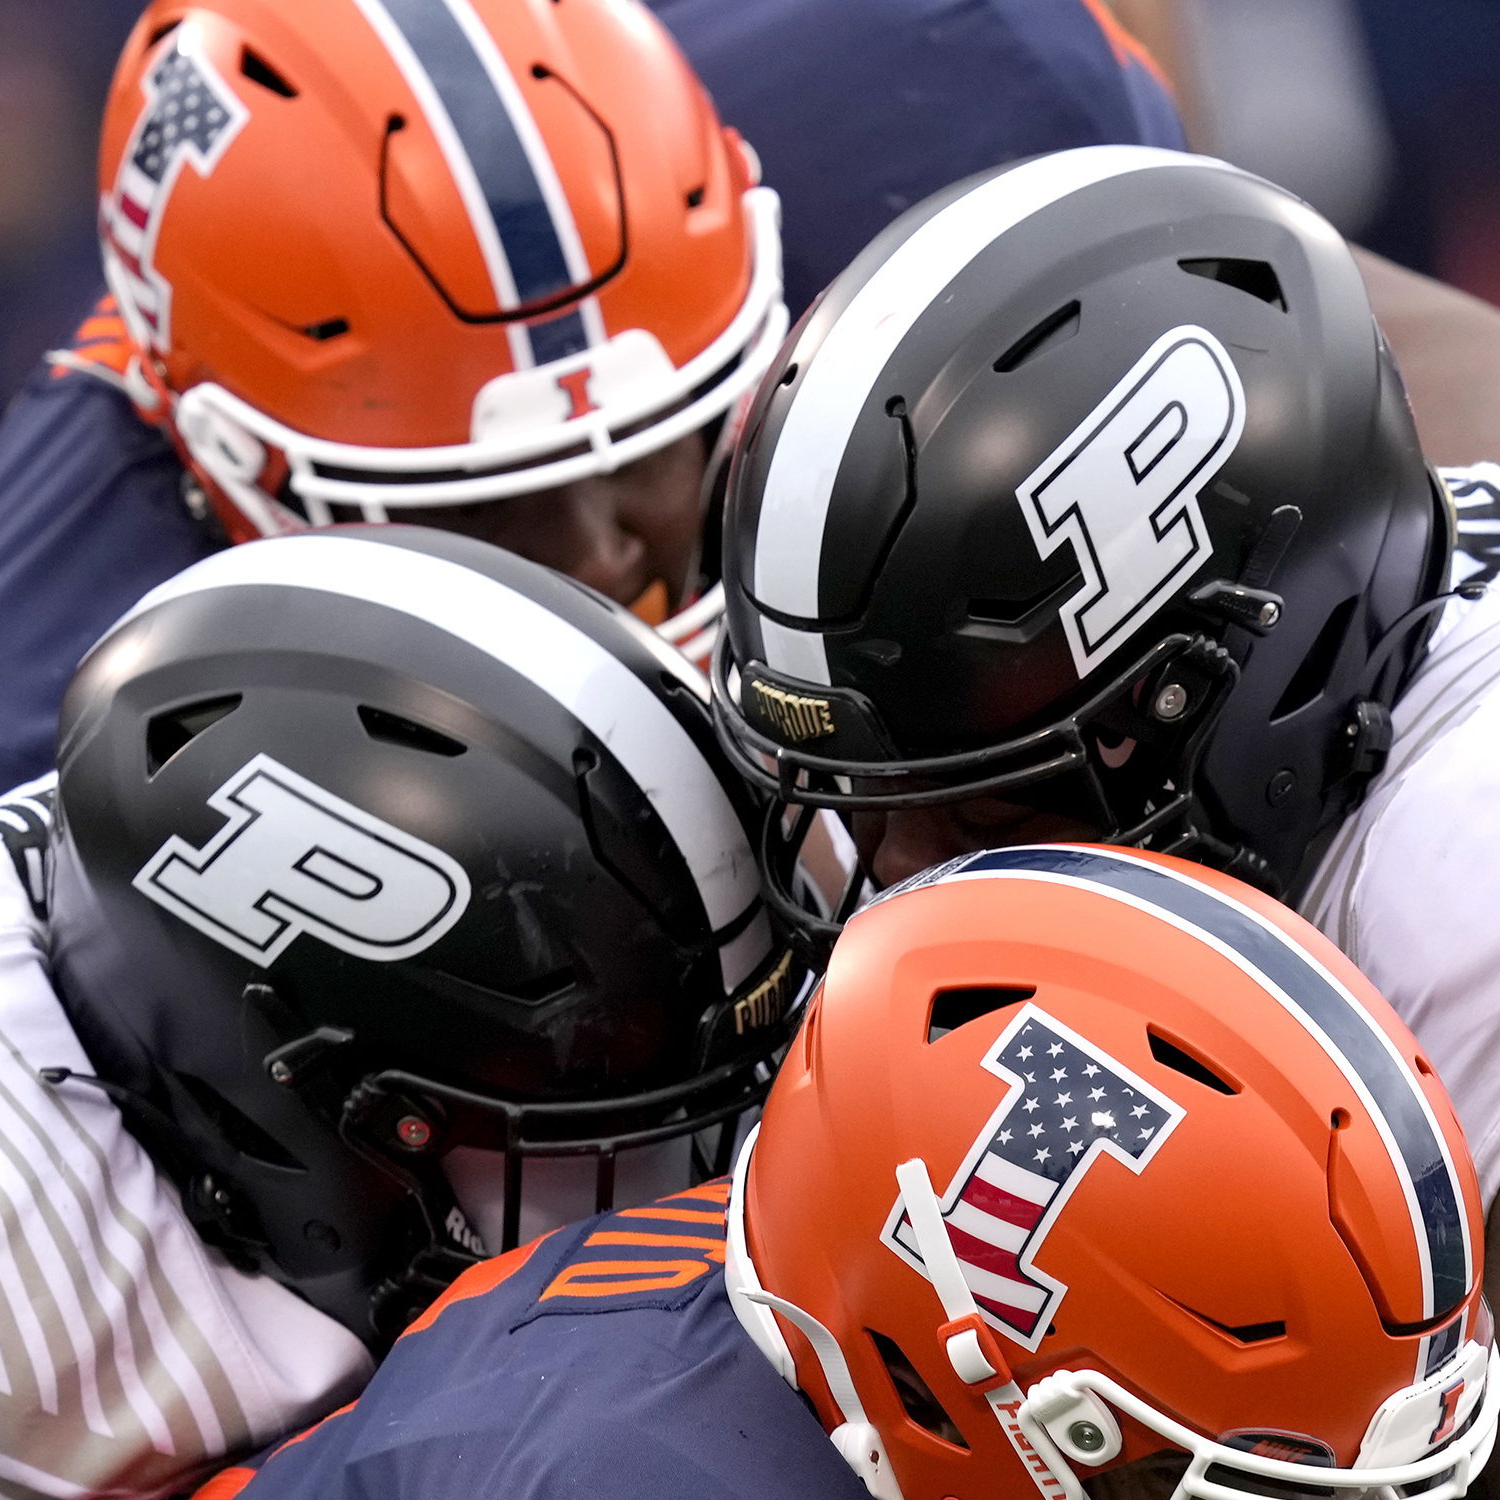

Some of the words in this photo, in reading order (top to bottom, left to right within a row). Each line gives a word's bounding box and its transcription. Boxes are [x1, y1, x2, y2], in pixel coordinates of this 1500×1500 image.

[556, 366, 601, 422] I
[1014, 324, 1246, 680] P
[131, 752, 472, 969] P
[1428, 1377, 1466, 1446] I
